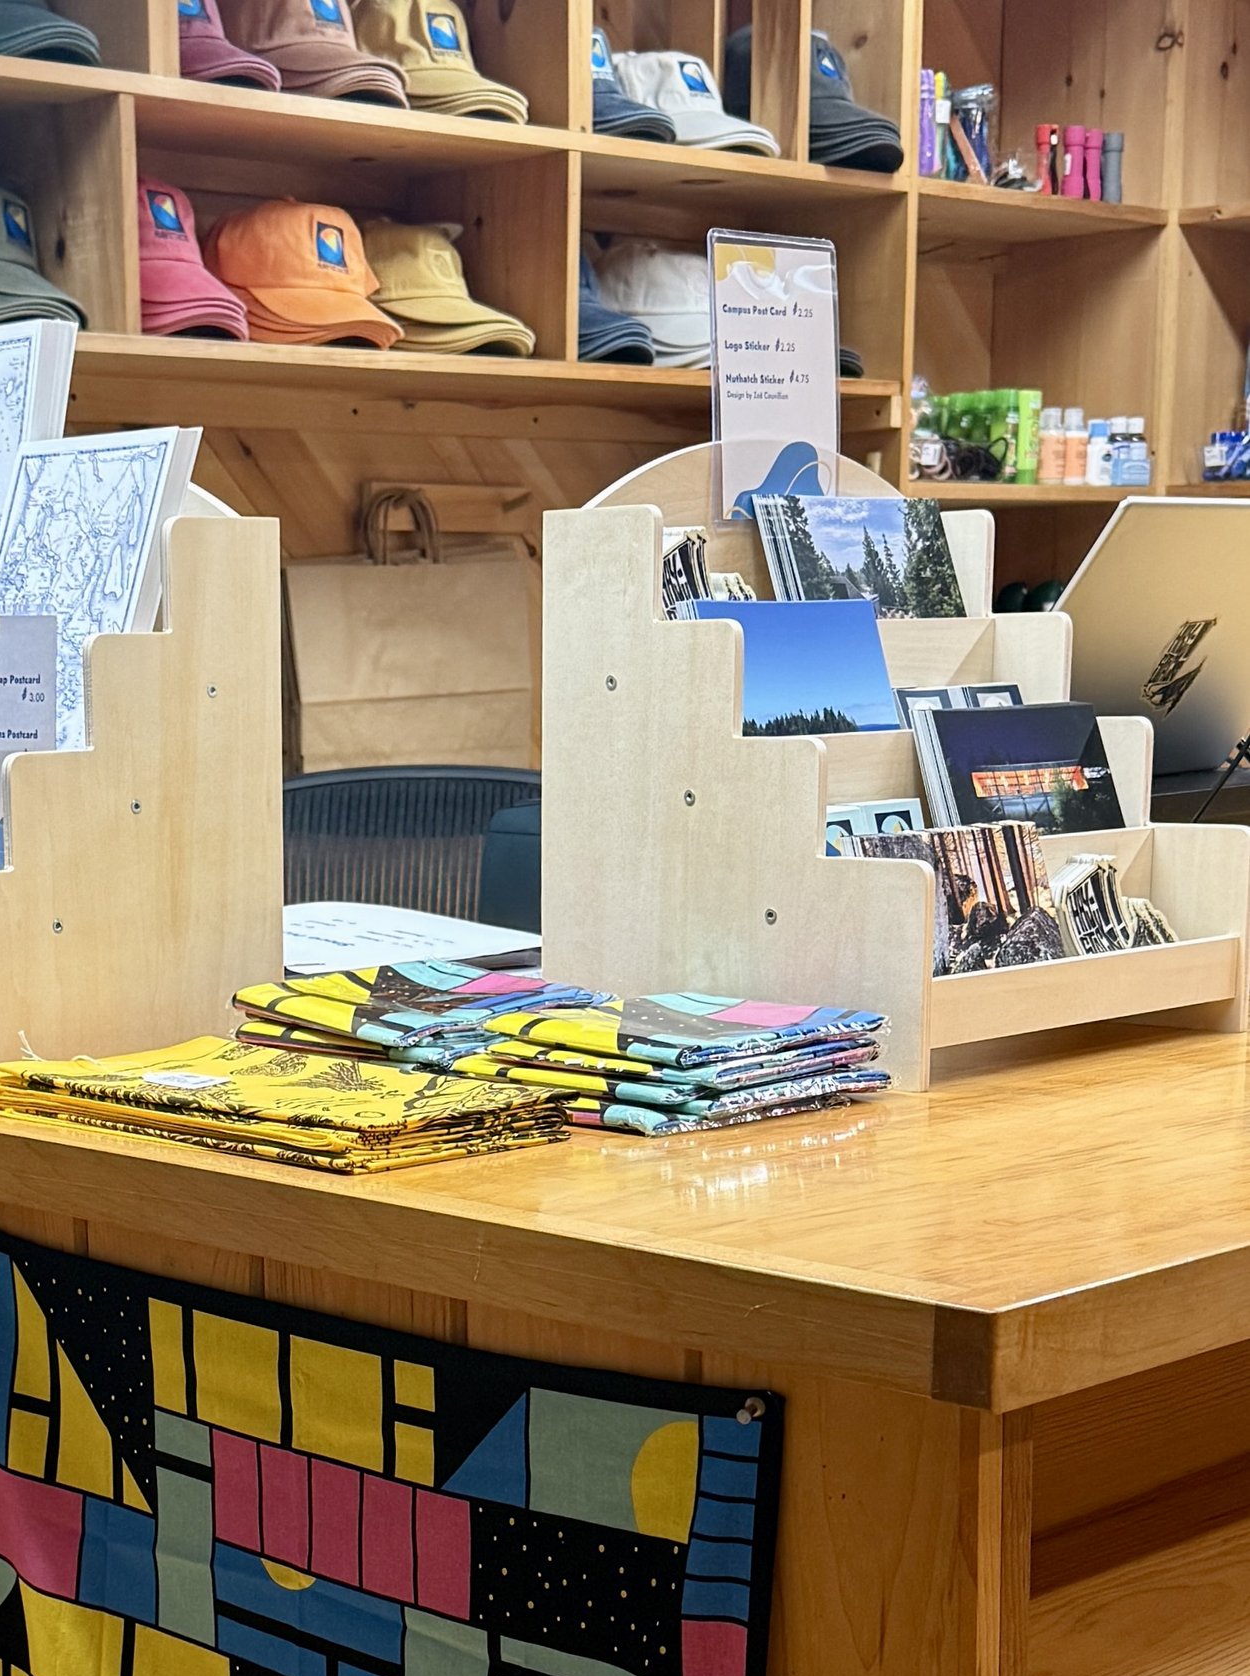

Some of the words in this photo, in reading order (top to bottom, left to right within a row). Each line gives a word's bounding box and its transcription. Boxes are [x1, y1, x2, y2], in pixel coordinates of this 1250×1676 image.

[722, 303, 751, 316] Campus
[752, 305, 768, 315] Post
[769, 306, 787, 316] Card
[724, 340, 743, 352] Logo
[744, 341, 770, 351] Sticker
[725, 373, 758, 384] Nuthatch
[759, 374, 785, 384] Sticker
[9, 674, 41, 684] Postcard
[7, 729, 38, 739] Postcard
